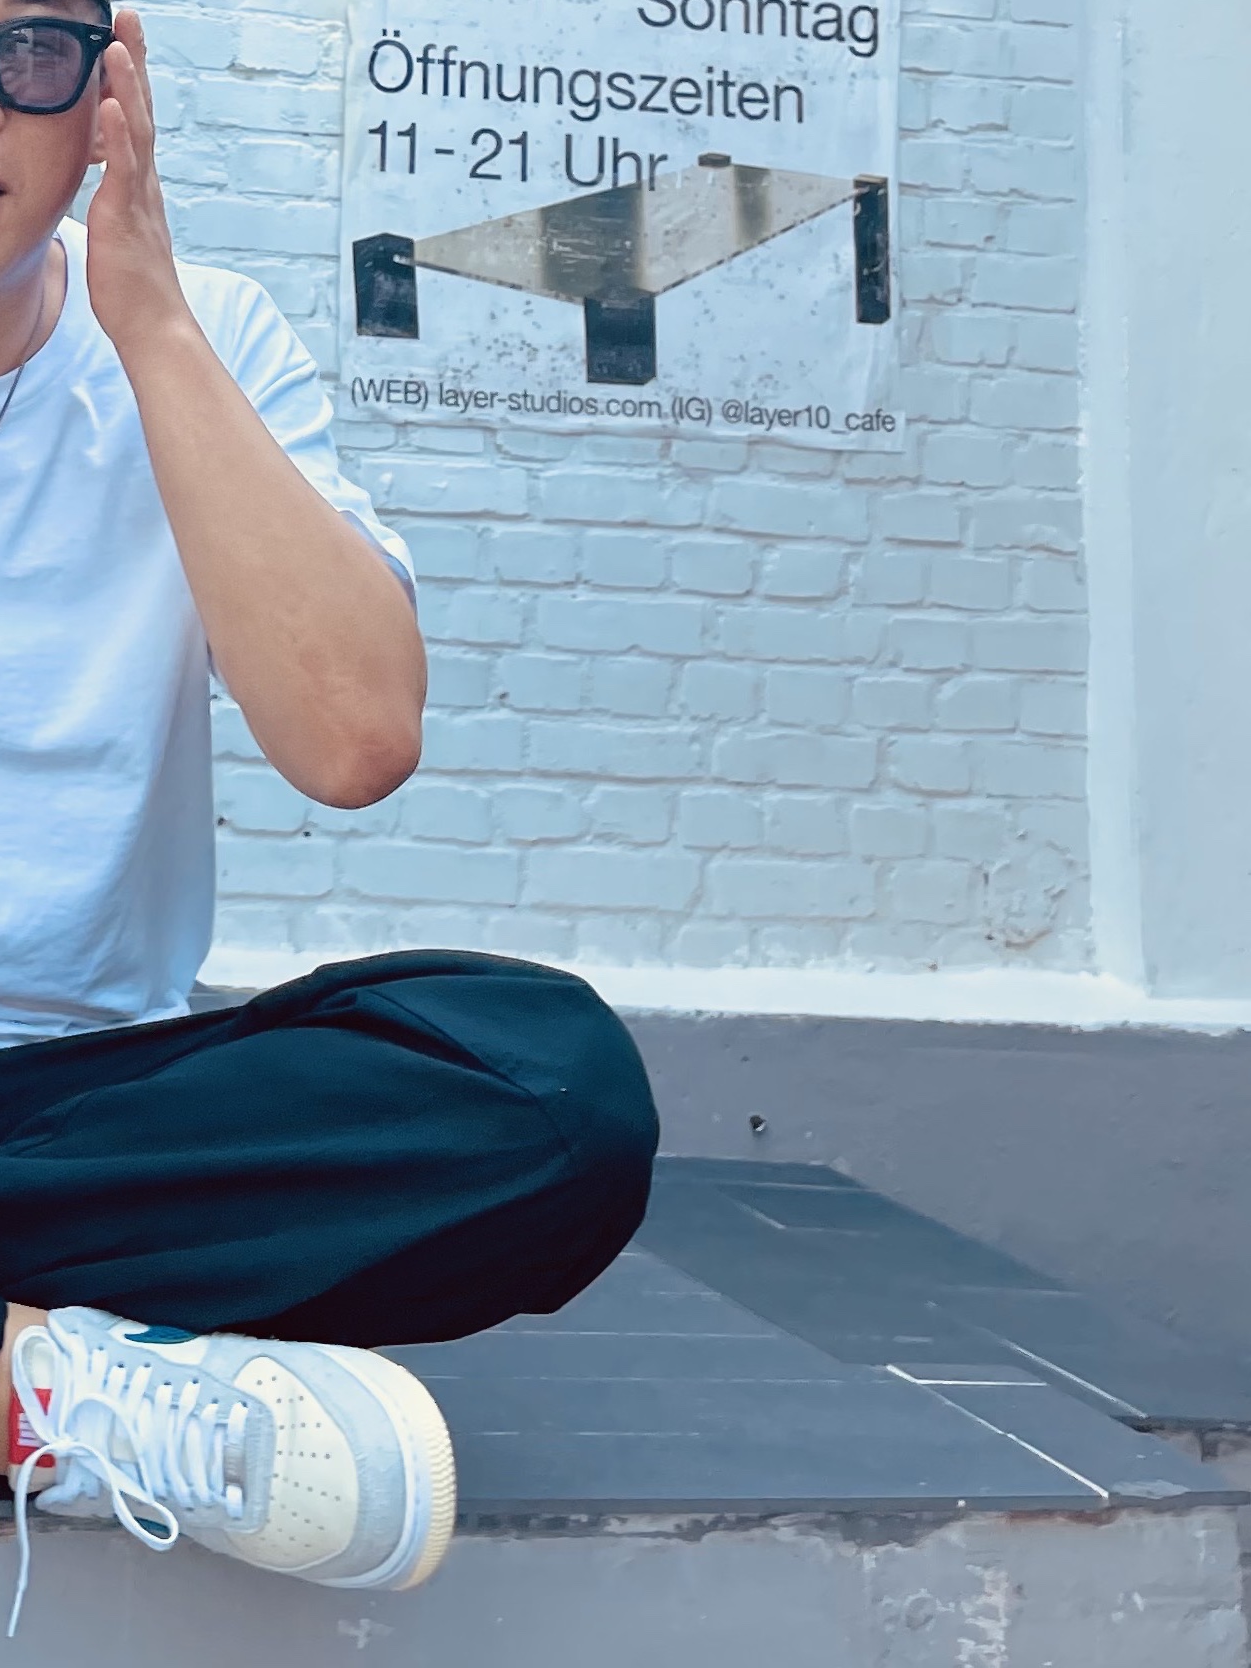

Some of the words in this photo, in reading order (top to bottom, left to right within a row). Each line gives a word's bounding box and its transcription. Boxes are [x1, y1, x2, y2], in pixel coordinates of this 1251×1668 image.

[367, 29, 804, 123] Öffnungszeiten
[565, 134, 668, 191] Uhr
[351, 377, 429, 411] (WEB)
[439, 382, 662, 417] layer-studios.com
[671, 396, 712, 427] (IG)
[722, 398, 896, 434] @layer10_cafe
